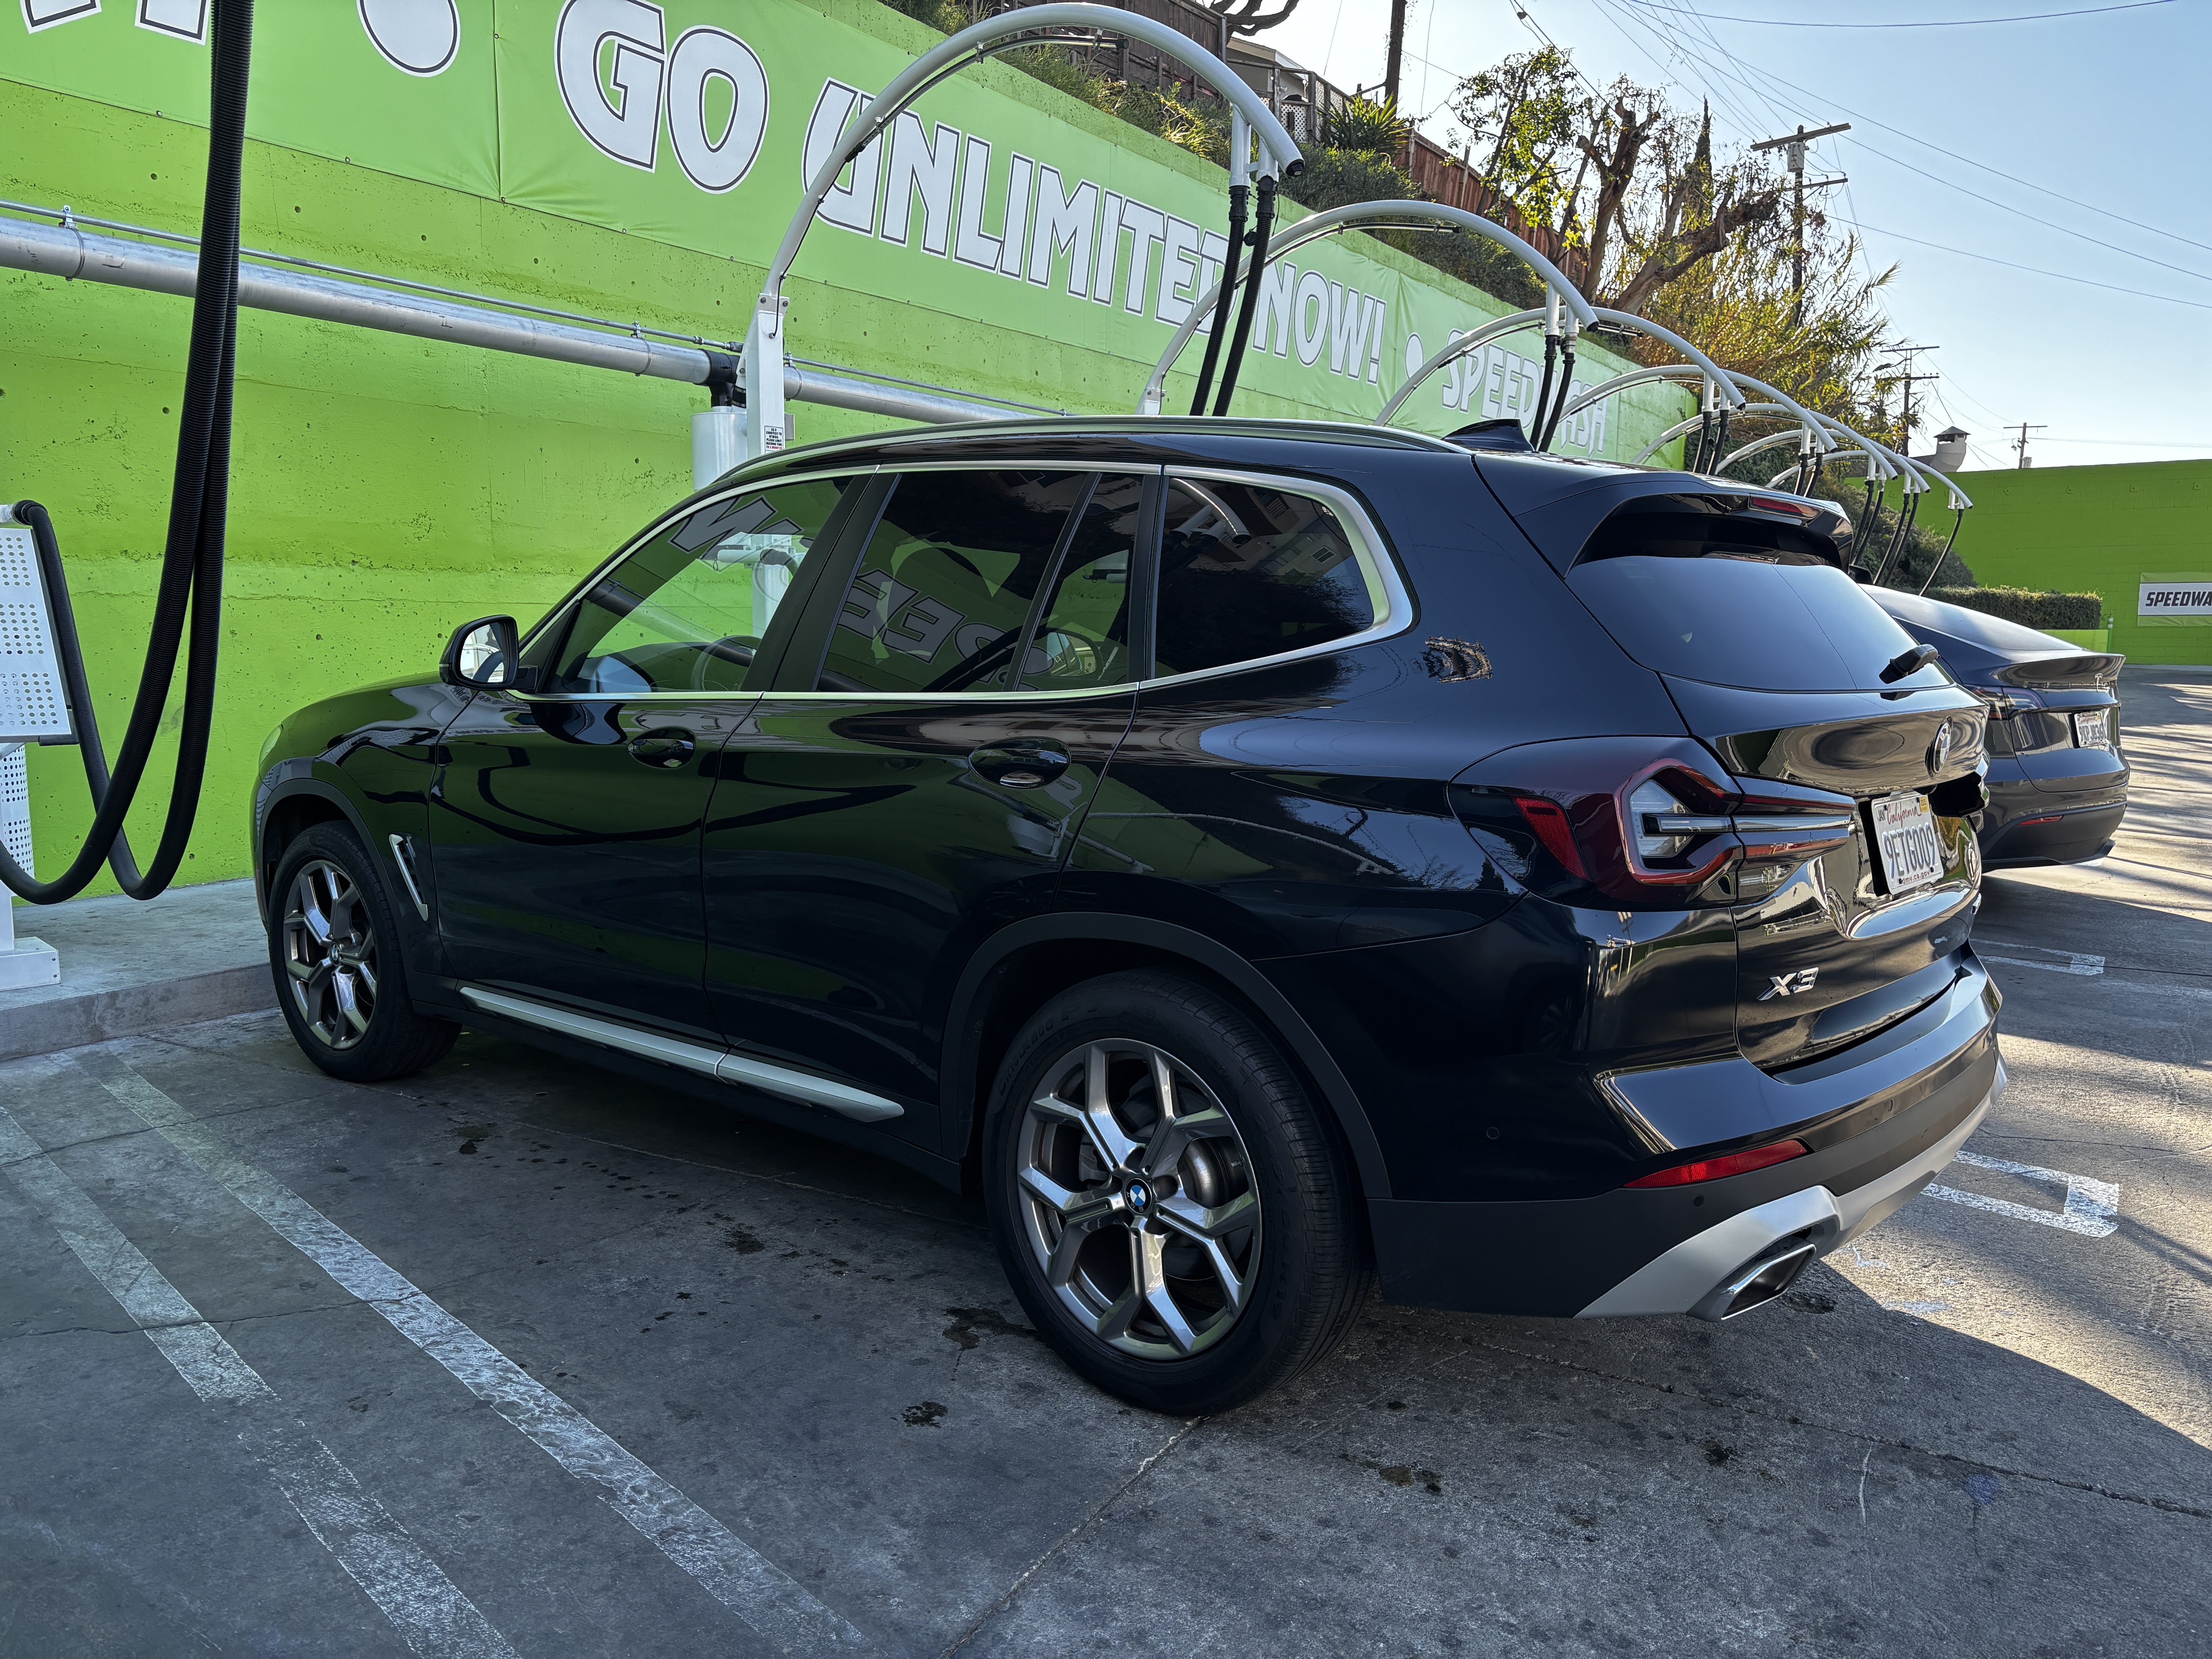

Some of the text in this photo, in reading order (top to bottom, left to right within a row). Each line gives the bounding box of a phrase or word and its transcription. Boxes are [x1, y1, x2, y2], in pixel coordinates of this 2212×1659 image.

[554, 0, 770, 194] GO
[1252, 256, 1387, 386] NOW!
[1887, 802, 1922, 828] California
[1882, 822, 1936, 881] 9ETG009
[1902, 870, 1930, 884] dmv.ca.gov
[1756, 967, 1819, 1001] X3
